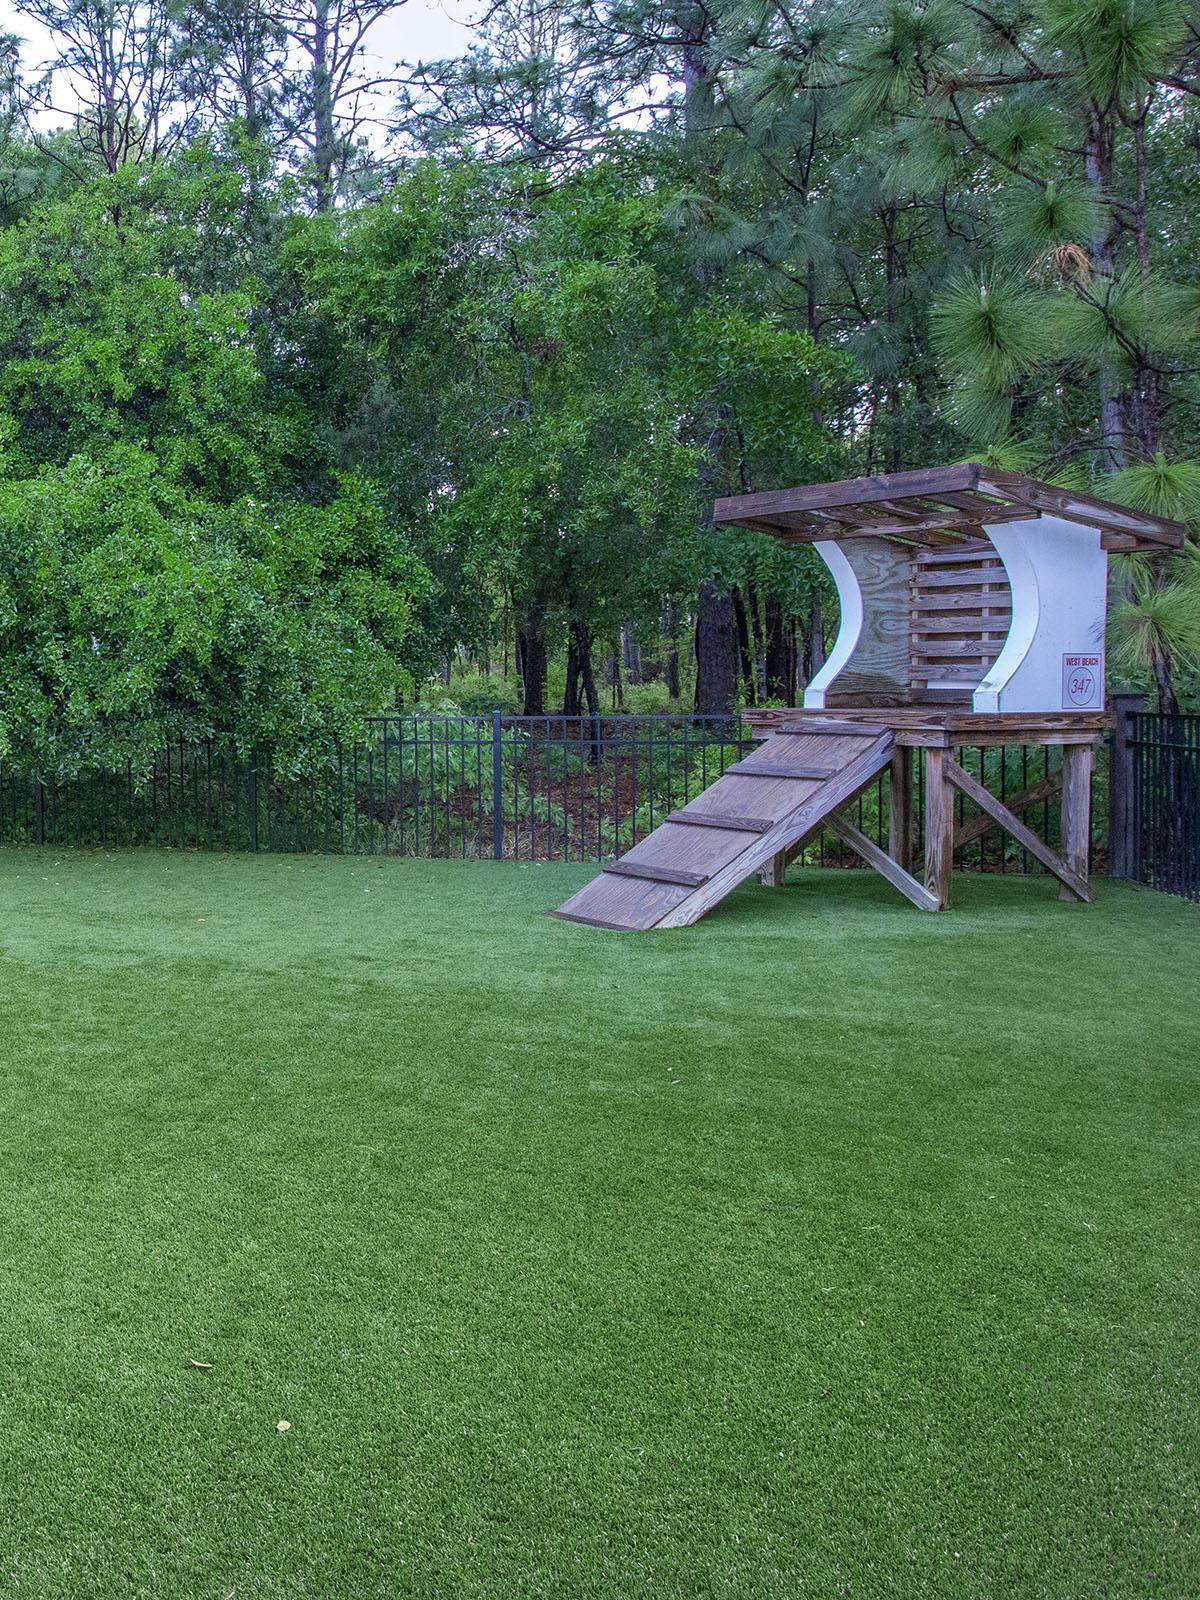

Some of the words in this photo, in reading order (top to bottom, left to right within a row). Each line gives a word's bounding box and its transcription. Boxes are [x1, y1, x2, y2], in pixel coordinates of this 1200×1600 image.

[1066, 658, 1080, 666] WEST
[1082, 658, 1099, 666] BEACH
[1071, 679, 1092, 694] 347
